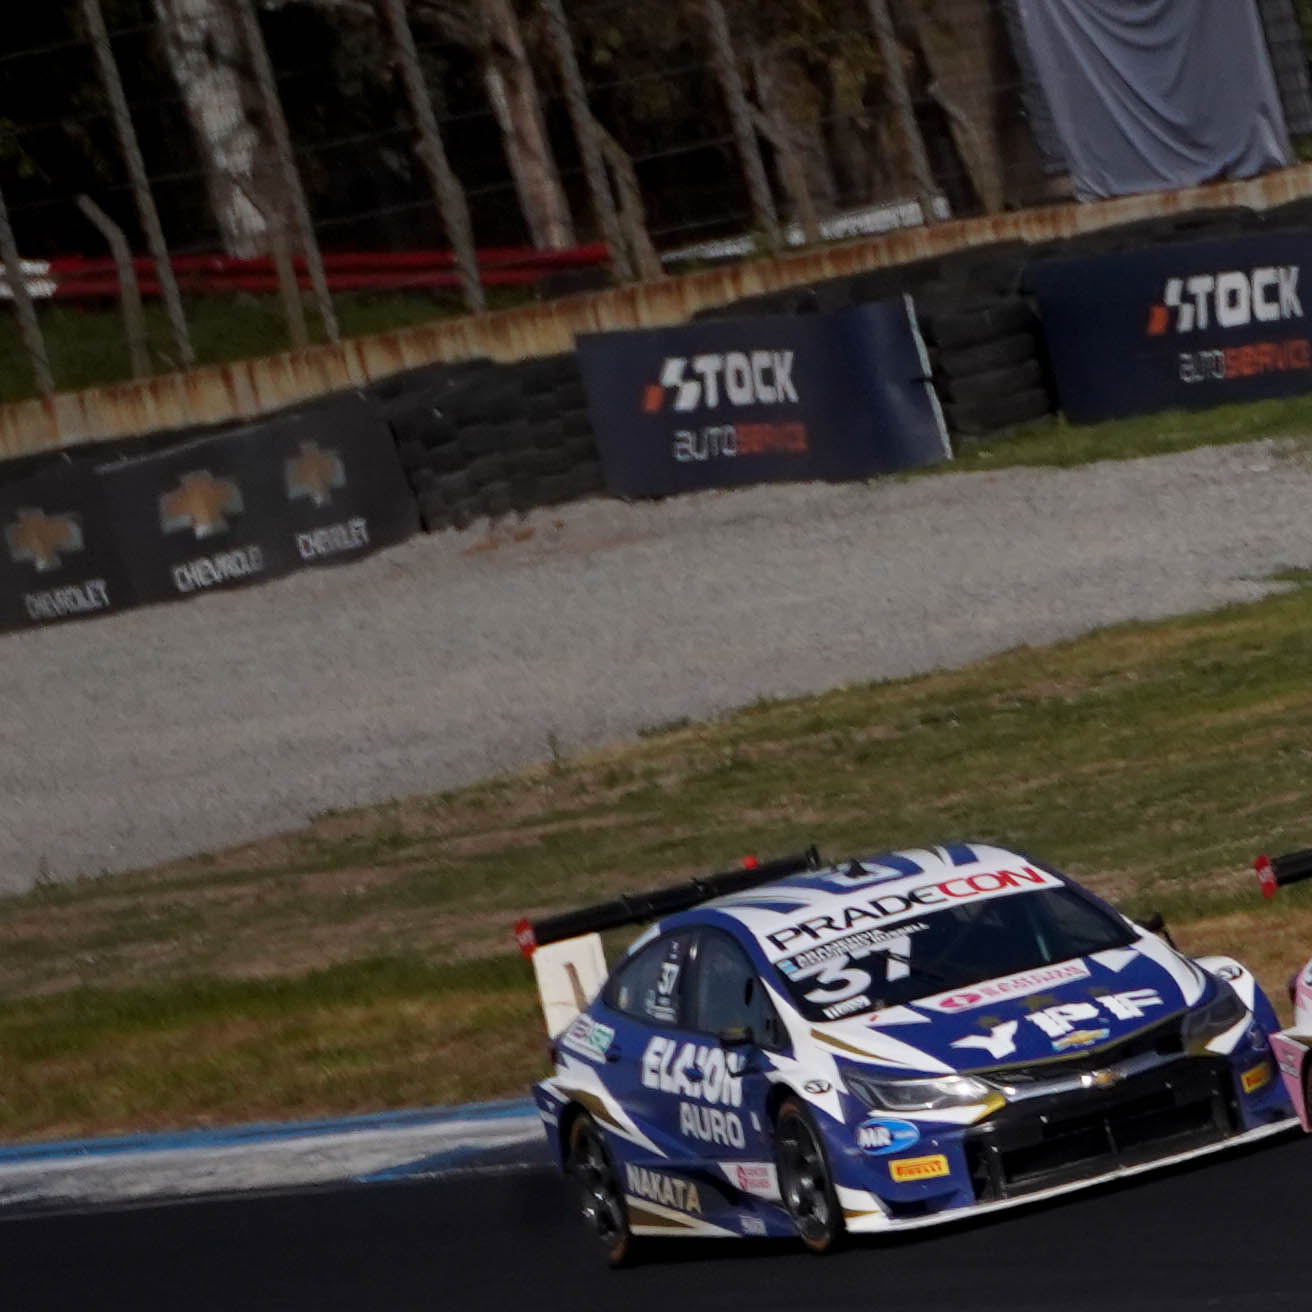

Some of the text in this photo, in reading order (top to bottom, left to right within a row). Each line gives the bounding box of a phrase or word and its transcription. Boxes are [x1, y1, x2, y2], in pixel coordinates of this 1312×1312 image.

[1162, 266, 1304, 333] STOCK
[658, 350, 800, 412] STOCK
[785, 935, 912, 1005] 37
[951, 987, 1164, 1060] YPF
[679, 1101, 747, 1150] AURO
